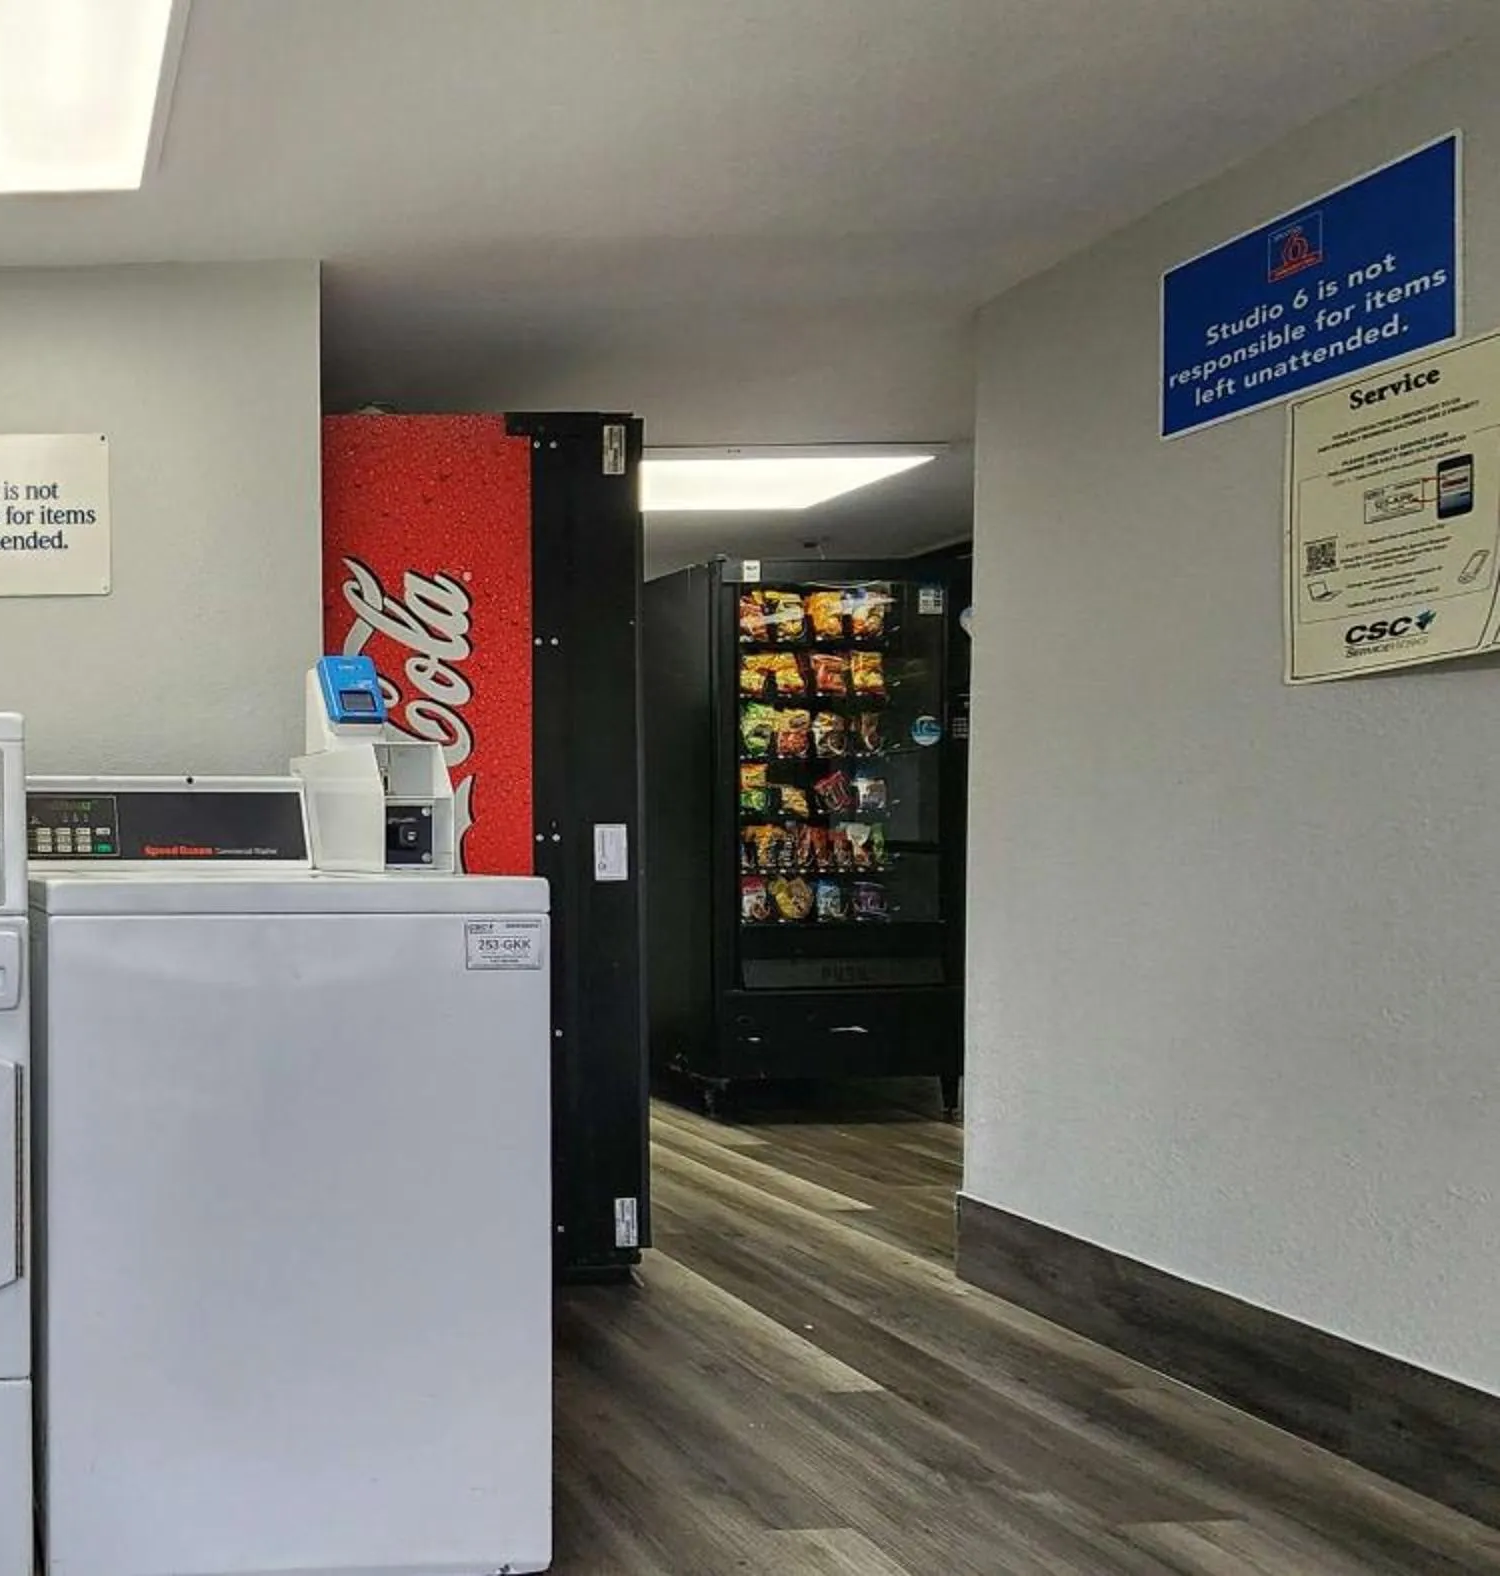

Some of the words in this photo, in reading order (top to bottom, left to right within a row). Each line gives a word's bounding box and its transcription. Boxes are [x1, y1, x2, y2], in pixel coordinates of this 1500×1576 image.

[1206, 303, 1283, 346] Studio
[1293, 289, 1308, 309] 6
[1318, 280, 1338, 300] is
[1348, 253, 1396, 288] not
[1169, 322, 1306, 389] responsible
[1316, 303, 1354, 332] for
[1365, 268, 1447, 312] items
[1195, 378, 1235, 407] left
[1244, 314, 1409, 388] unattended.
[1350, 369, 1441, 412] Service
[4, 481, 19, 501] is
[26, 482, 60, 501] not
[6, 505, 34, 525] for
[40, 505, 96, 525] items
[1346, 616, 1413, 644] CSC
